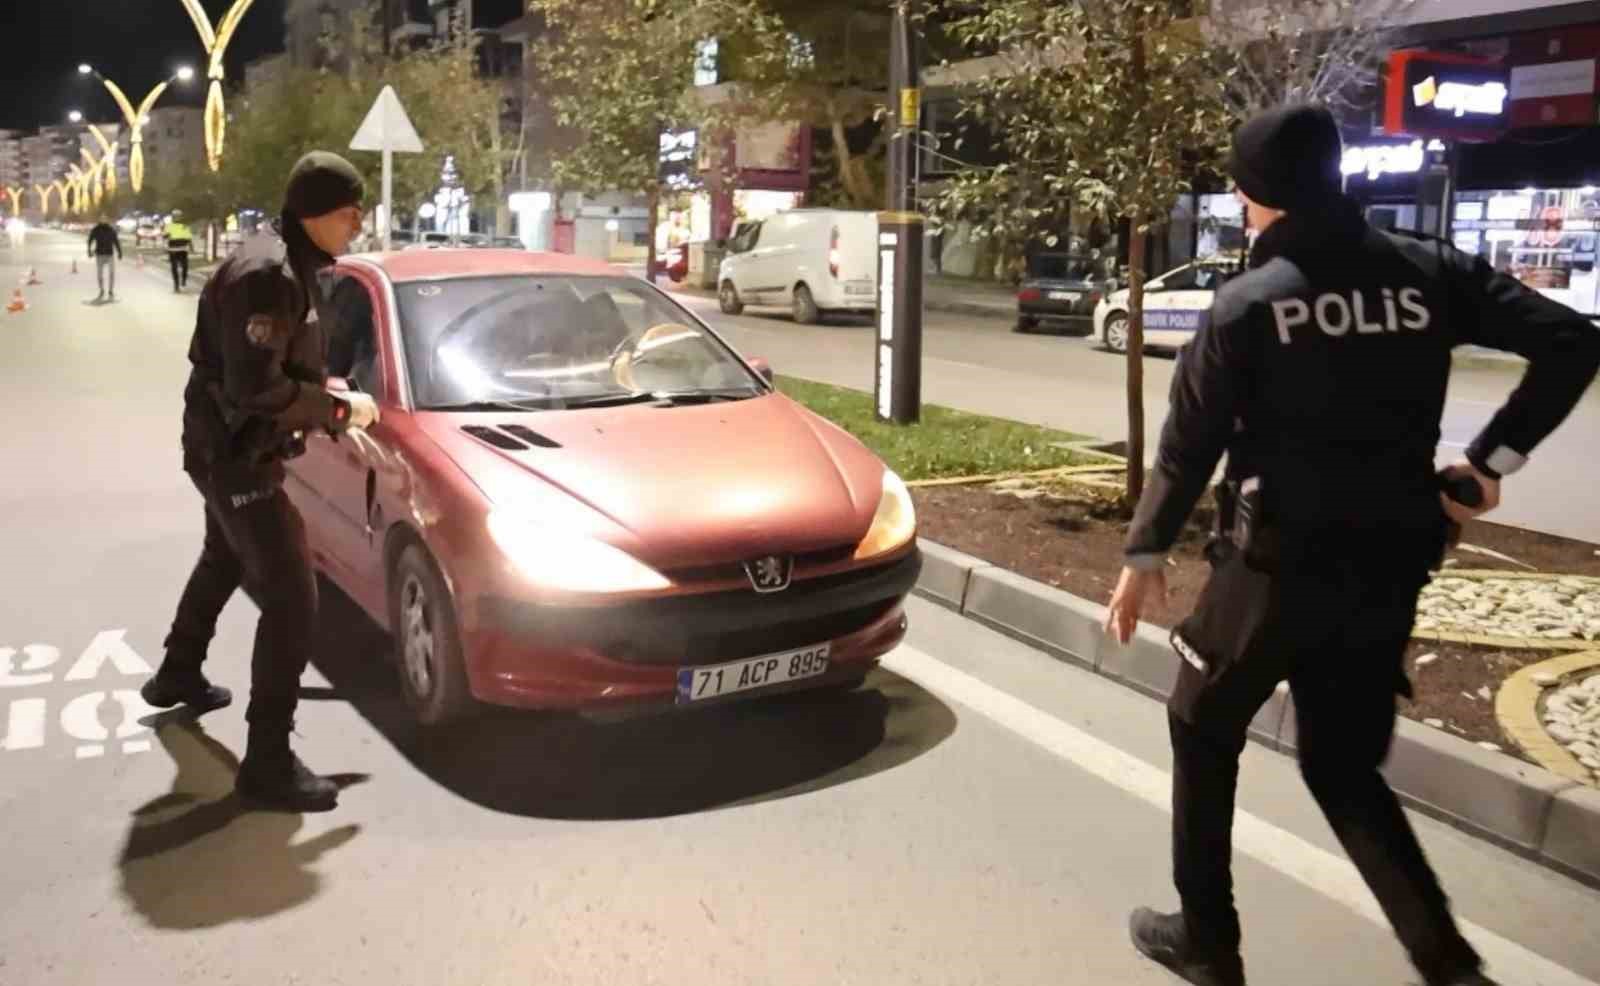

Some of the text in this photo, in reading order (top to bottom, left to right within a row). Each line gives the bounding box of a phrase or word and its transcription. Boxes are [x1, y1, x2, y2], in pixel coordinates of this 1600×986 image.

[697, 670, 724, 696] 71
[738, 659, 779, 688] ACP
[788, 648, 827, 677] 895
